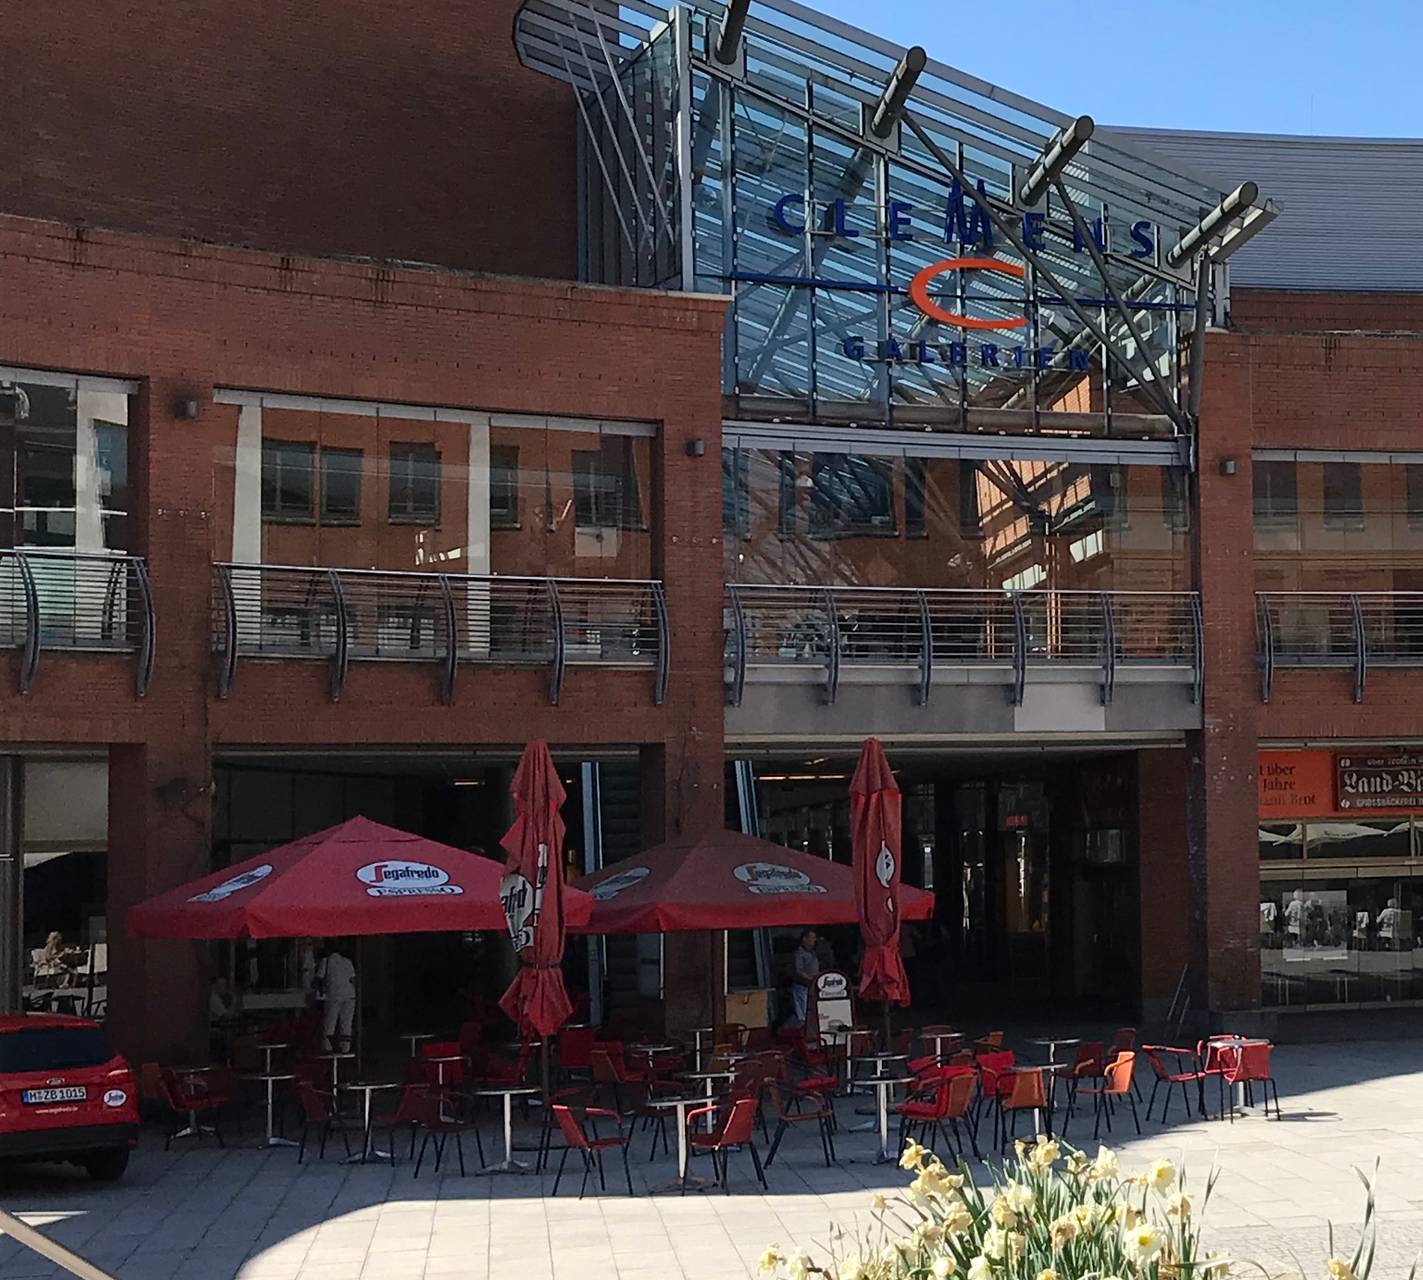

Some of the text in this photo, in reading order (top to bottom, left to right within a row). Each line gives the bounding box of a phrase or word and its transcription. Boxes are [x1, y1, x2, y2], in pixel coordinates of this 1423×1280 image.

[773, 178, 1158, 258] CLEMENS
[843, 335, 1090, 372] GALERIEN
[1266, 763, 1296, 776] über
[1263, 777, 1296, 792] Jahre
[369, 864, 440, 883] Segafredo
[376, 885, 456, 896] ESPRESSO
[59, 1088, 85, 1099] 1015
